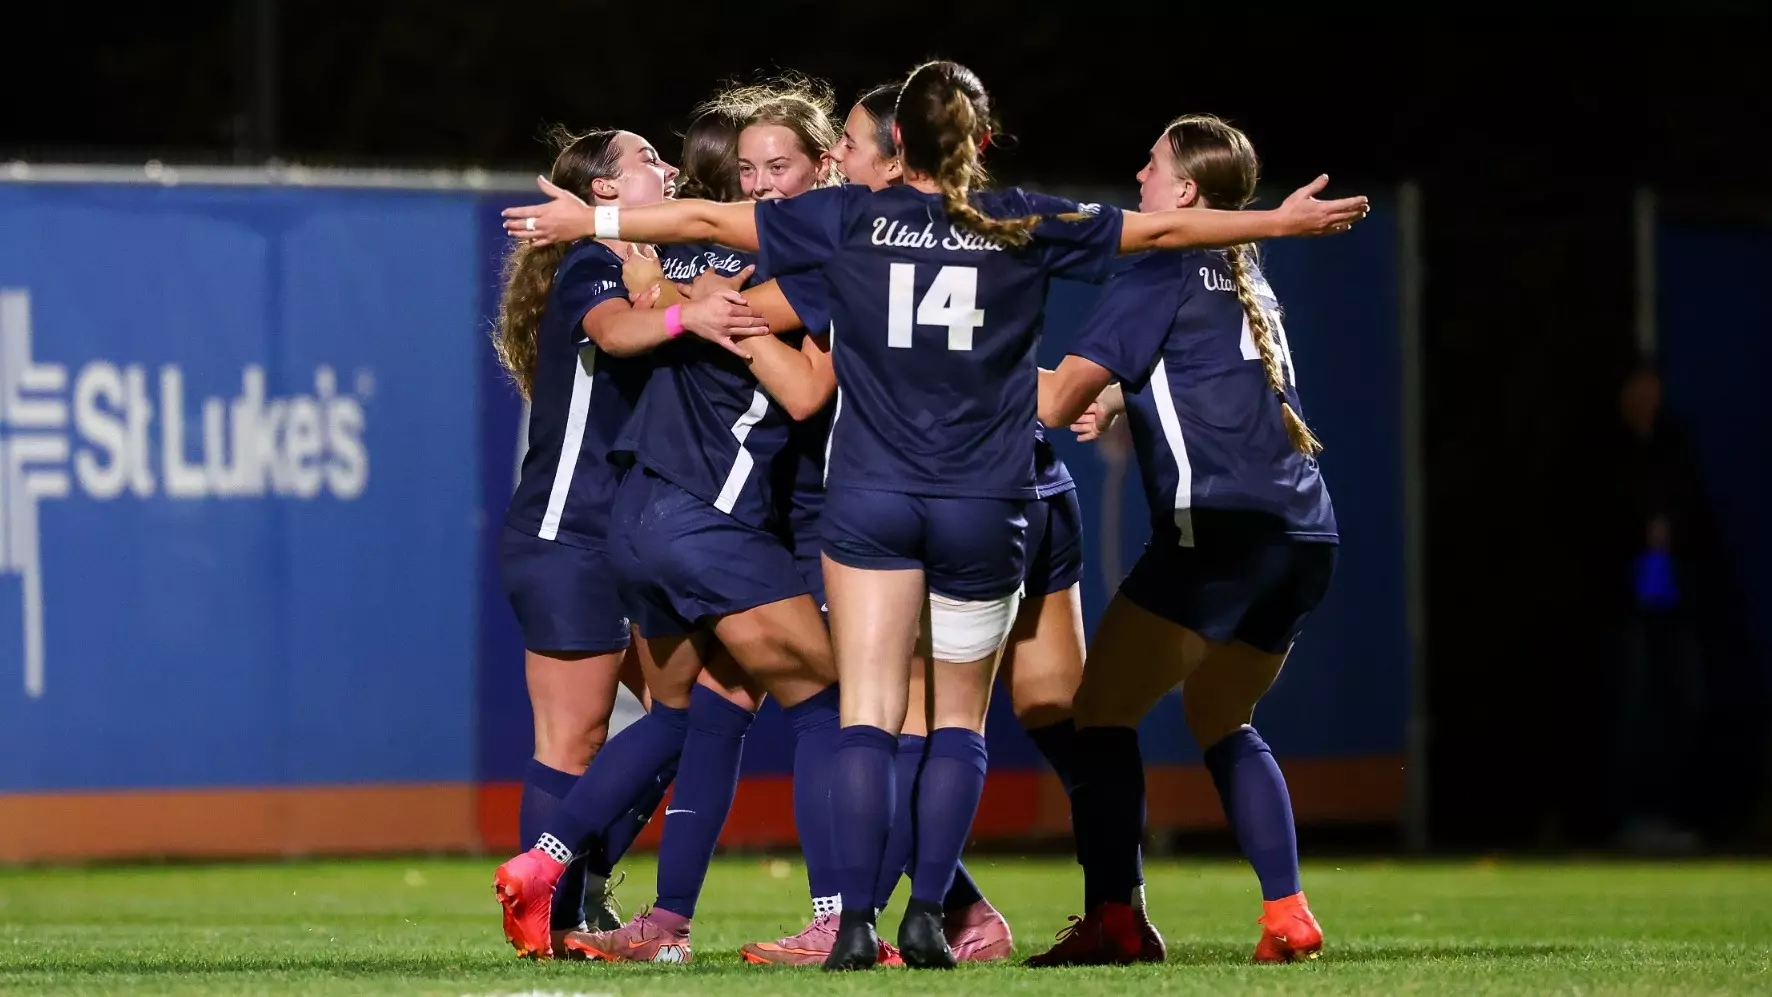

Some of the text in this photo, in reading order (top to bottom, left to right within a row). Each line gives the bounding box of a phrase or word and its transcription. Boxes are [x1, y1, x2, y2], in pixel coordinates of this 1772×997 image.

[871, 217, 938, 249] Utah
[663, 252, 741, 279] Utah State
[1199, 267, 1237, 291] Uta
[887, 262, 985, 351] 14
[74, 361, 369, 498] St Luke's
